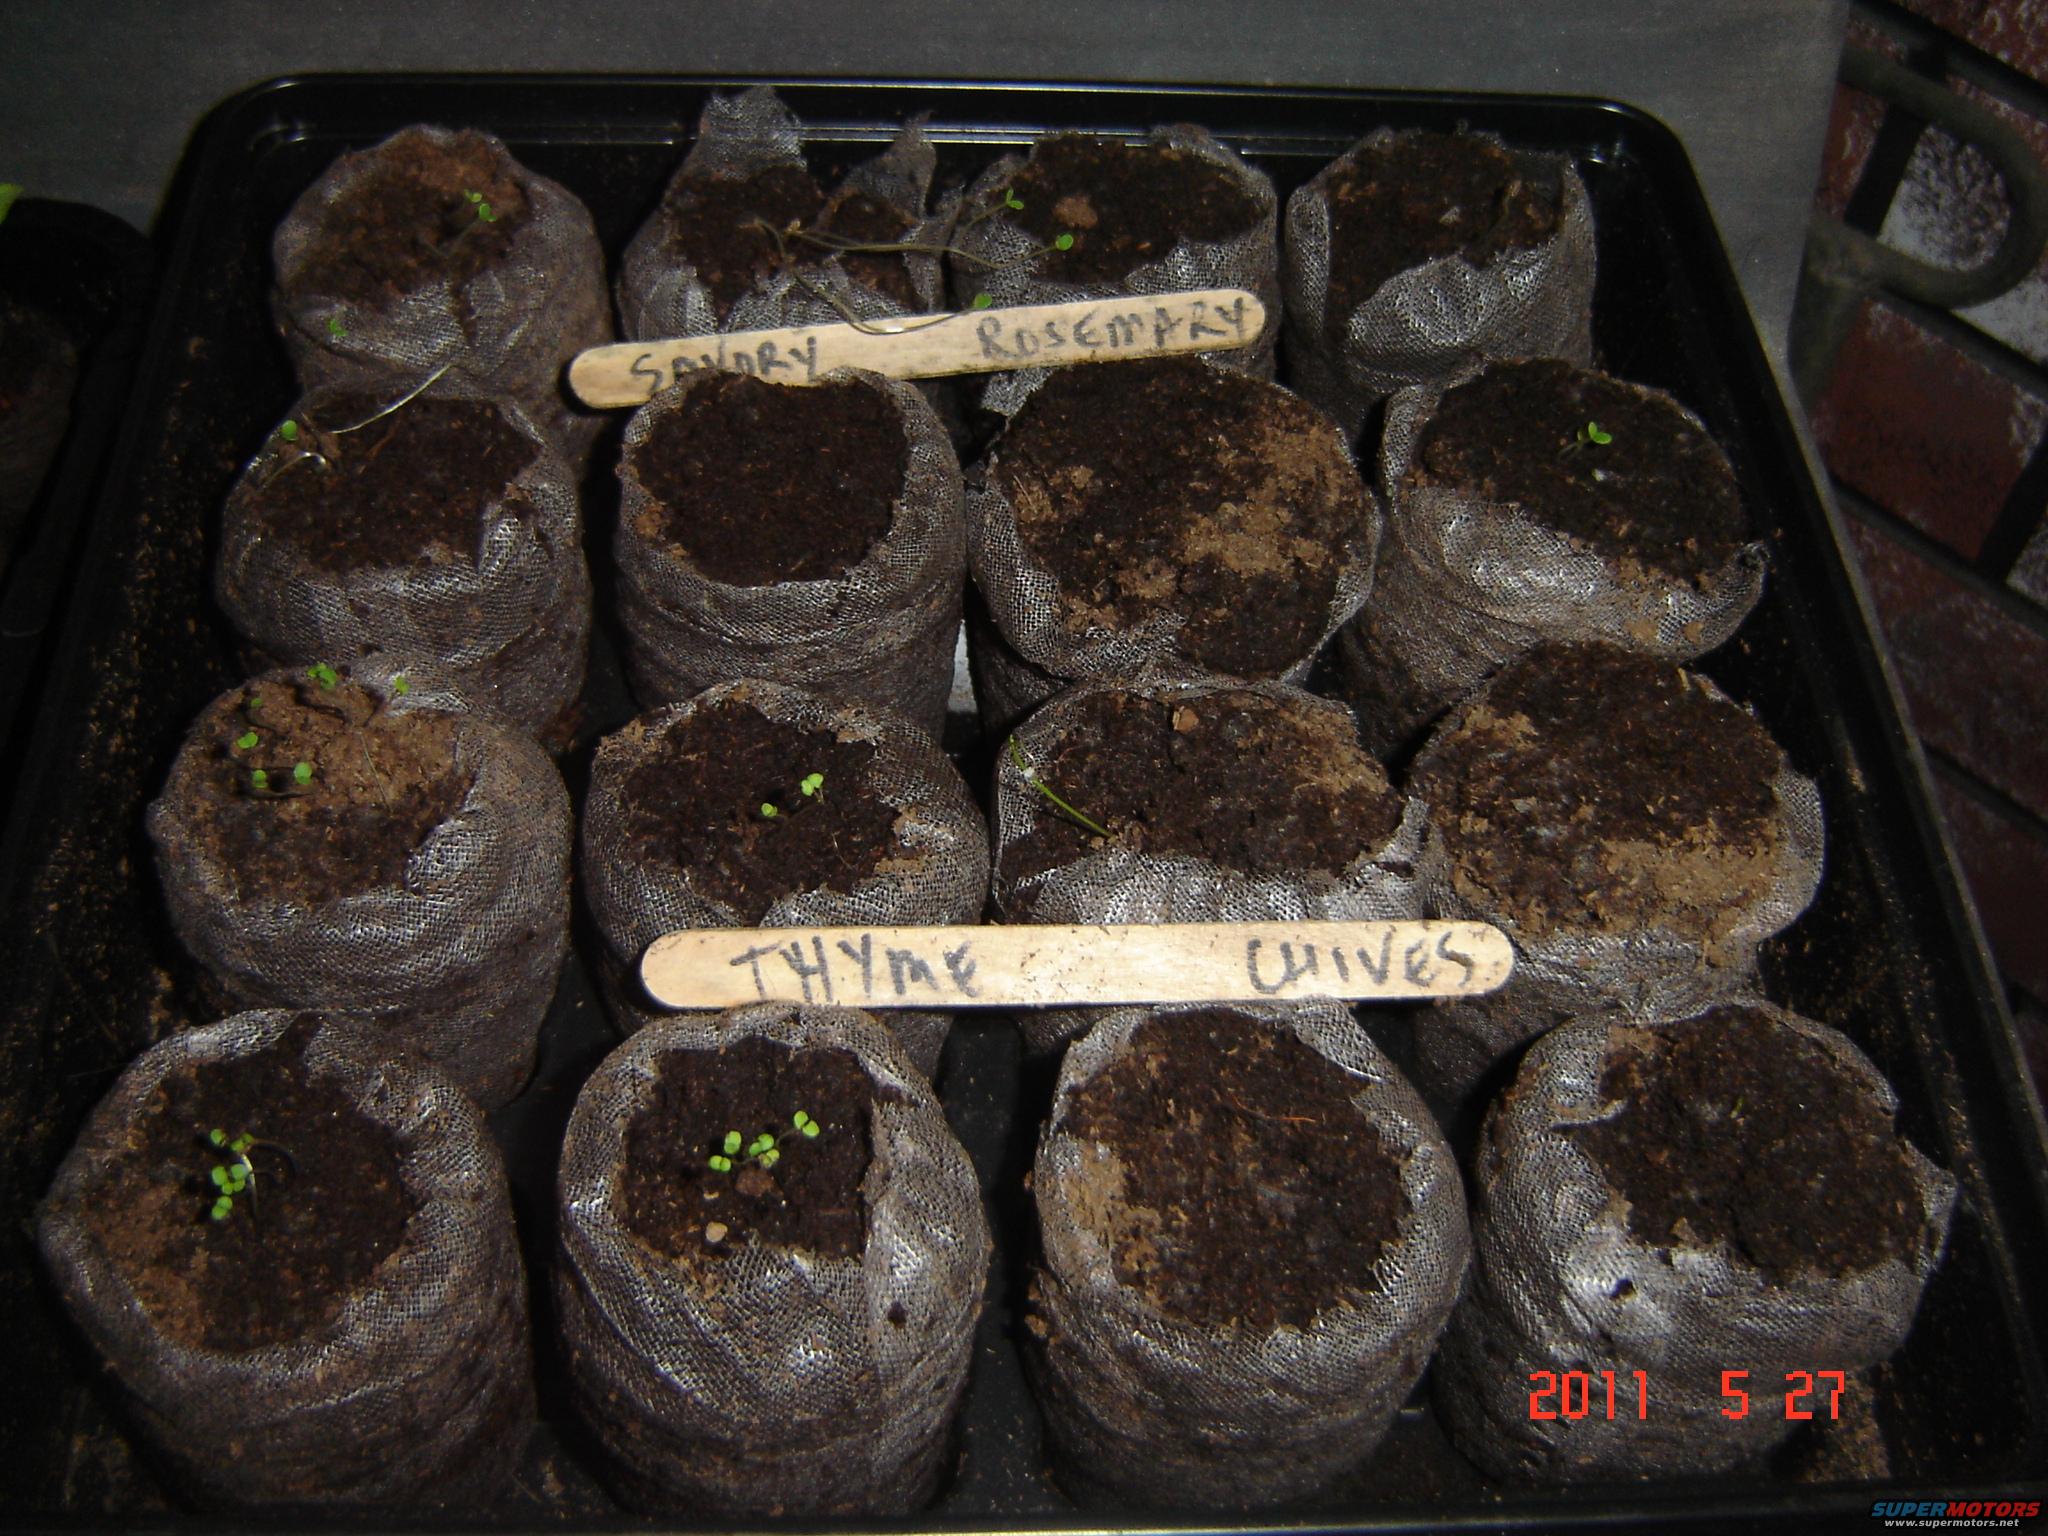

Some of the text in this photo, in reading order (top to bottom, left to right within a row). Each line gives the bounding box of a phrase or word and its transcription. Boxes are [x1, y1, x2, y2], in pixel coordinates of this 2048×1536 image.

[976, 296, 1249, 361] ROSEMARY
[729, 925, 1476, 1004] THYME CHIVES
